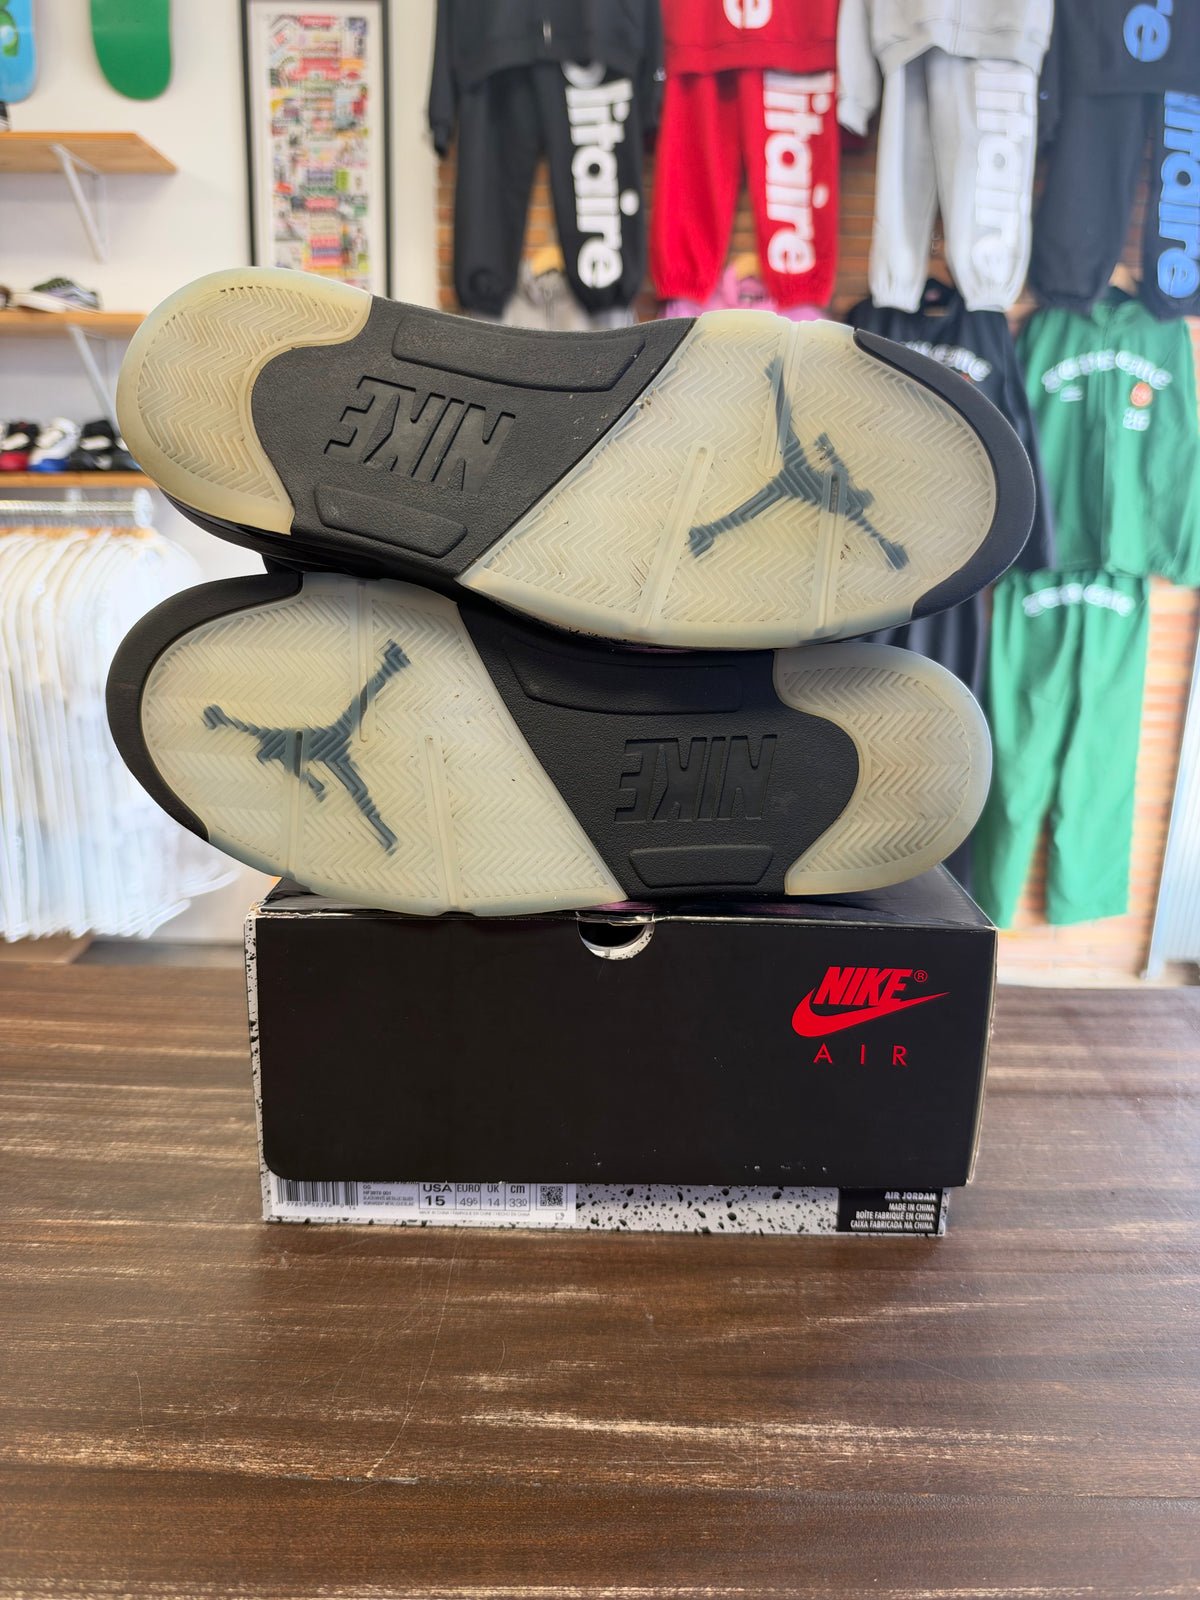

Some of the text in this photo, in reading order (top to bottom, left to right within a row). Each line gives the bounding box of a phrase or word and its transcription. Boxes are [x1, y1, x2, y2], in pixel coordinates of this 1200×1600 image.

[323, 375, 516, 494] NIKE
[614, 734, 777, 824] NIKE
[813, 1042, 908, 1066] AIR
[423, 1184, 452, 1192] USA
[457, 1184, 480, 1192] EURO
[487, 1184, 499, 1192] UK
[425, 1196, 446, 1206] 15
[488, 1198, 500, 1206] 14
[884, 1192, 936, 1200] AIR JORDAN
[916, 1204, 935, 1212] CHINA
[906, 1212, 914, 1220] EN
[850, 1220, 868, 1228] CAIXA
[870, 1220, 902, 1228] FABRICADA
[914, 1222, 932, 1230] CHINA
